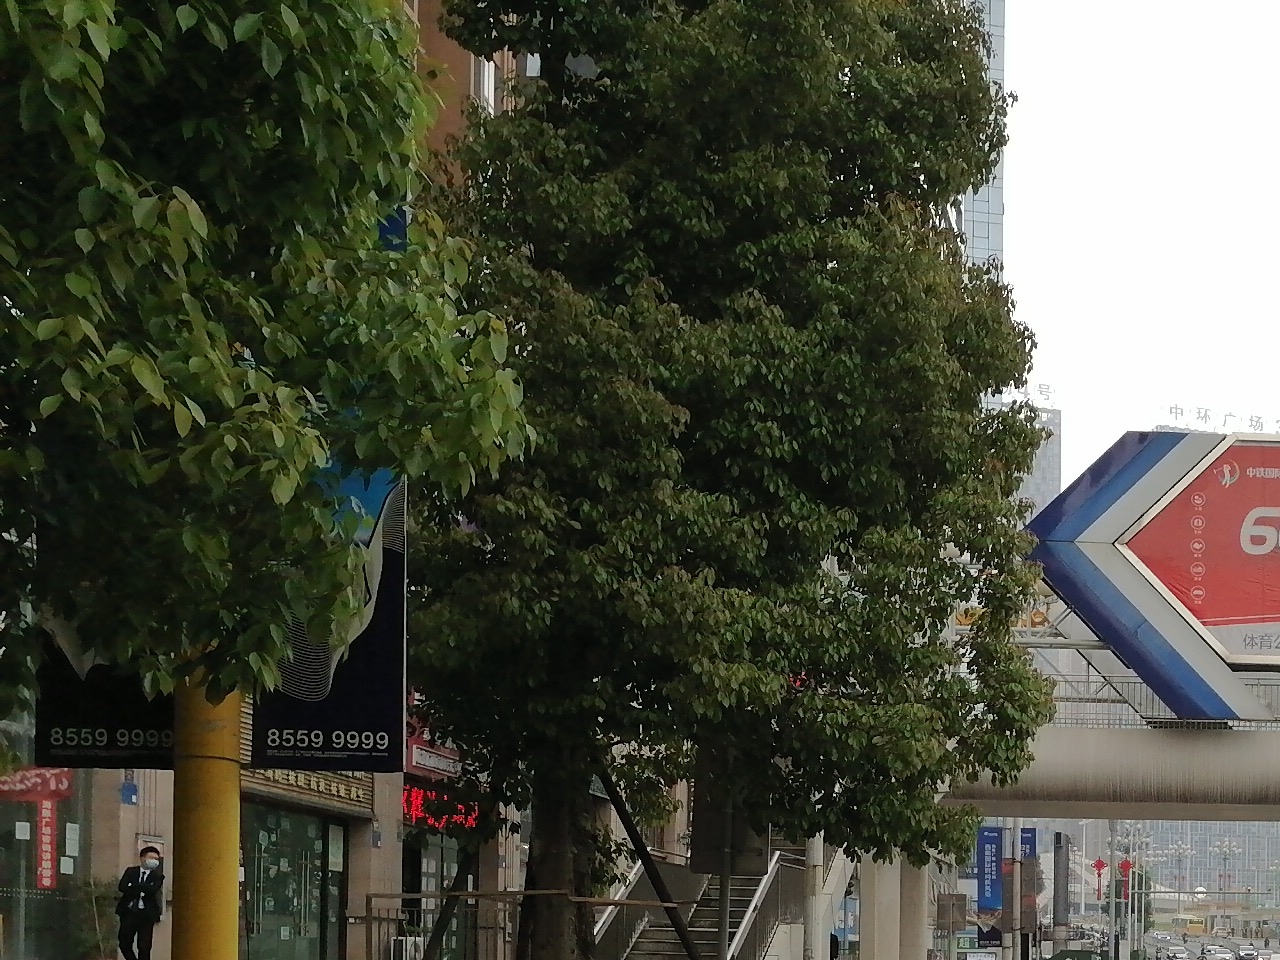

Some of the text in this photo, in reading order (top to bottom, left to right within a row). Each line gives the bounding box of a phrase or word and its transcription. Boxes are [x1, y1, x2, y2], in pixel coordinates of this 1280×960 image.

[50, 727, 174, 747] 8559 9999
[266, 728, 389, 750] 8559 9999
